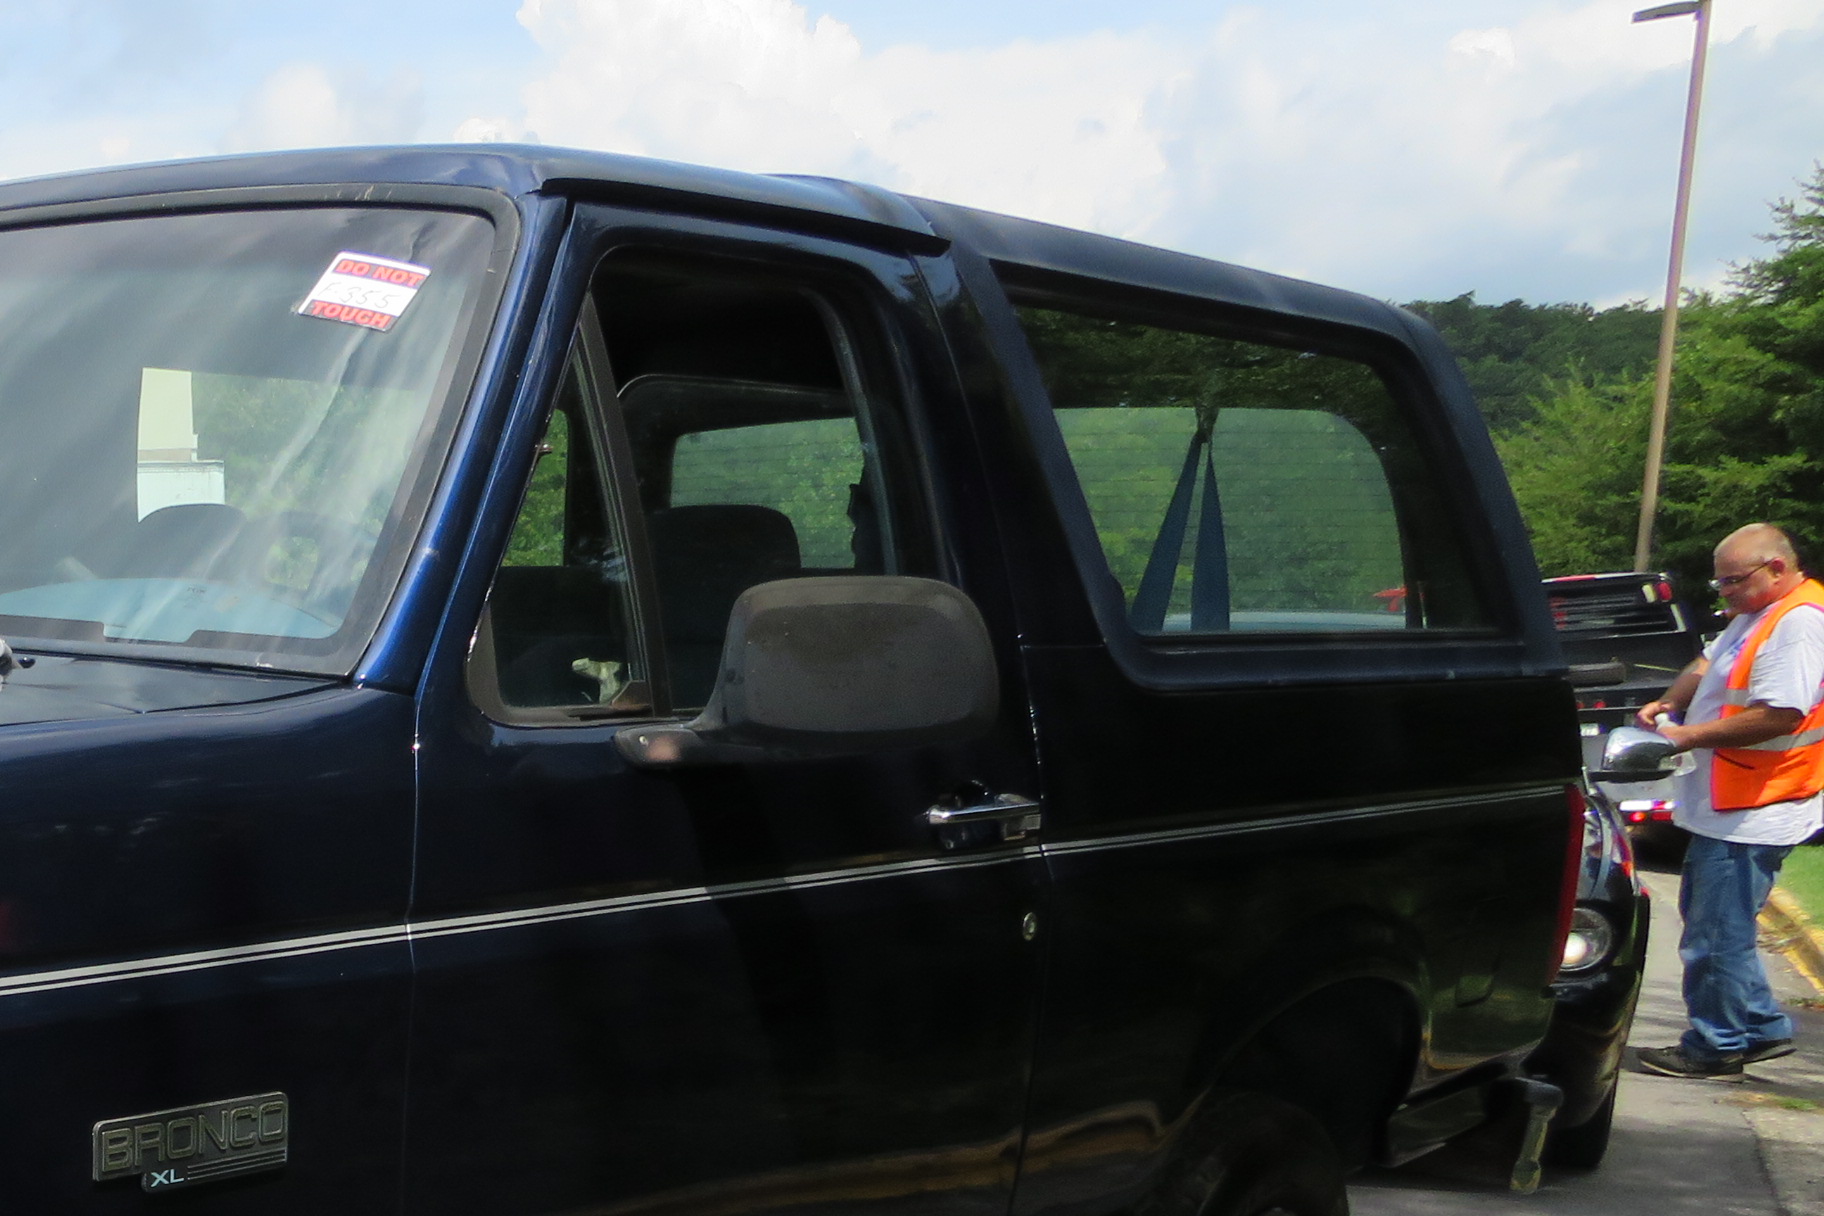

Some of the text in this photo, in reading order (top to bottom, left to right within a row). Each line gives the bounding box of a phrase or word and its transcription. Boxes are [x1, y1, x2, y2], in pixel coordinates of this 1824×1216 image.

[335, 260, 425, 287] DO NOT
[312, 301, 392, 328] TOUCH
[101, 1100, 288, 1173] BRONCO
[150, 1169, 185, 1187] XL
